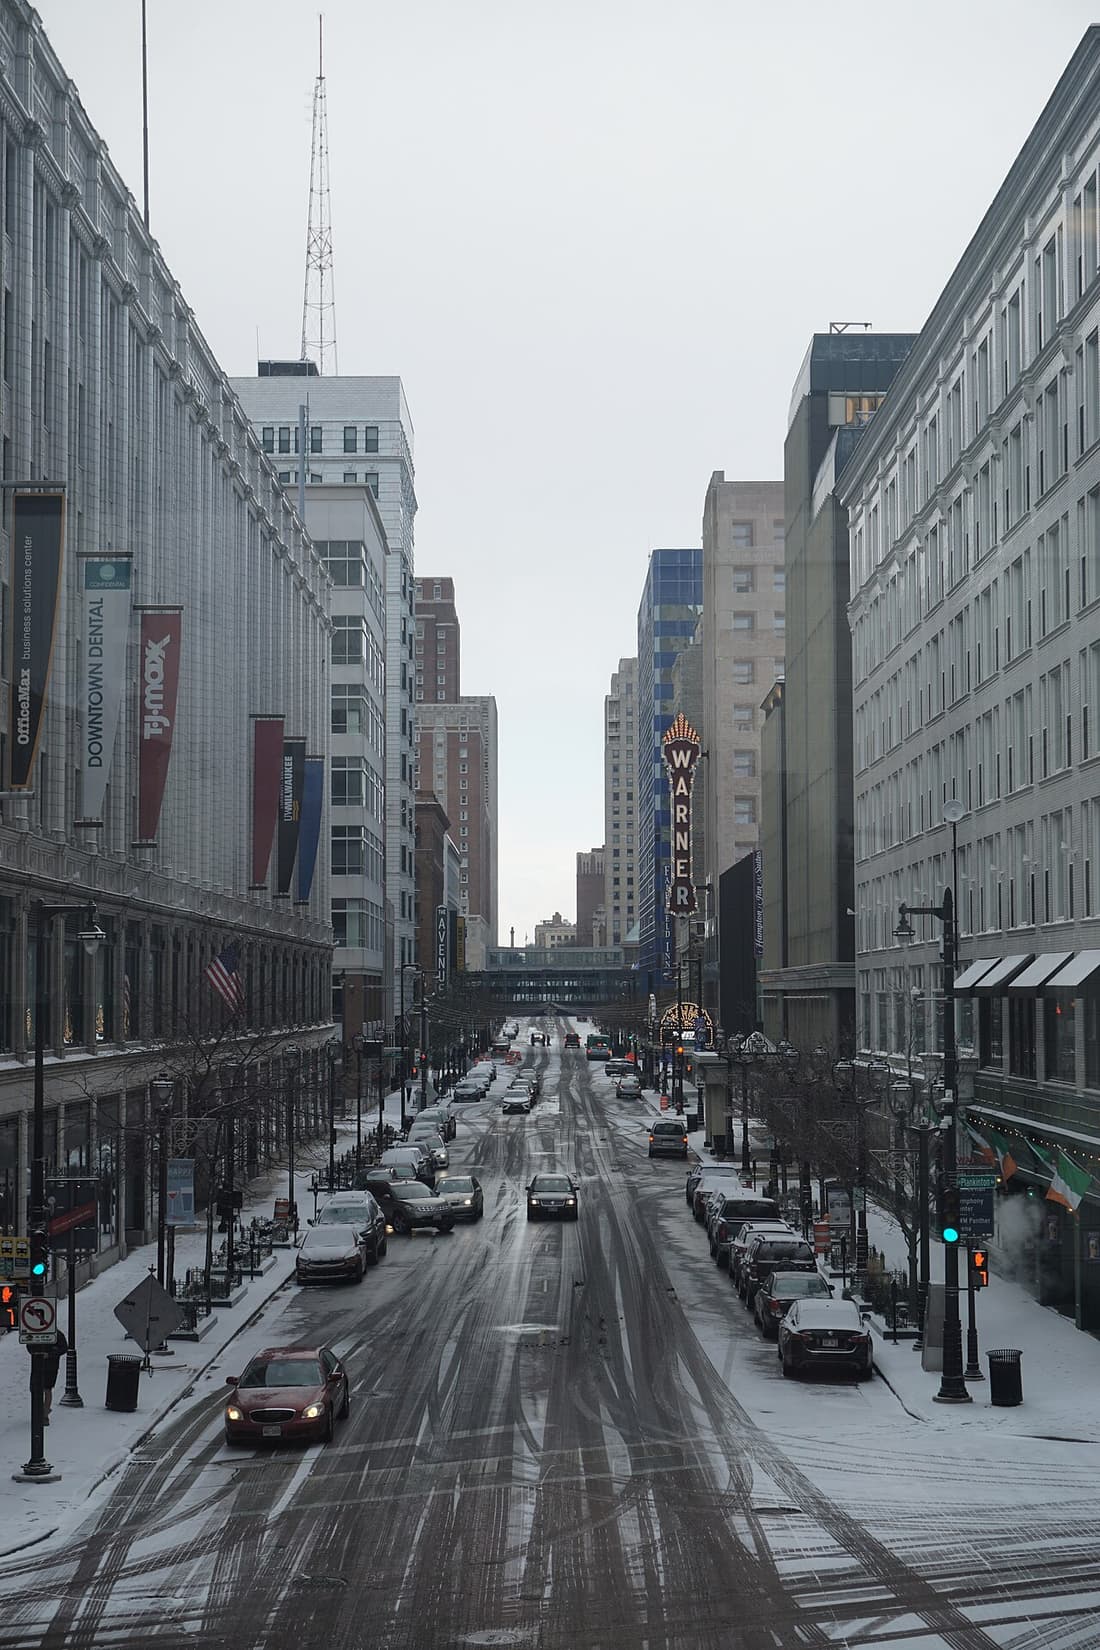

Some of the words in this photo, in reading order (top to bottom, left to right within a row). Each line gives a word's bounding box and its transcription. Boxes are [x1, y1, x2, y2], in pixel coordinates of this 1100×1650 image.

[23, 535, 33, 567] center
[22, 568, 32, 614] solutions
[21, 615, 31, 660] business
[88, 597, 104, 658] DENTAL
[16, 668, 30, 745] OfficeMax
[87, 662, 104, 768] DOWNTOWN
[671, 749, 691, 906] WARNER
[753, 849, 763, 874] Suites
[754, 910, 764, 954] Hampton
[960, 1177, 990, 1188] Plankinton
